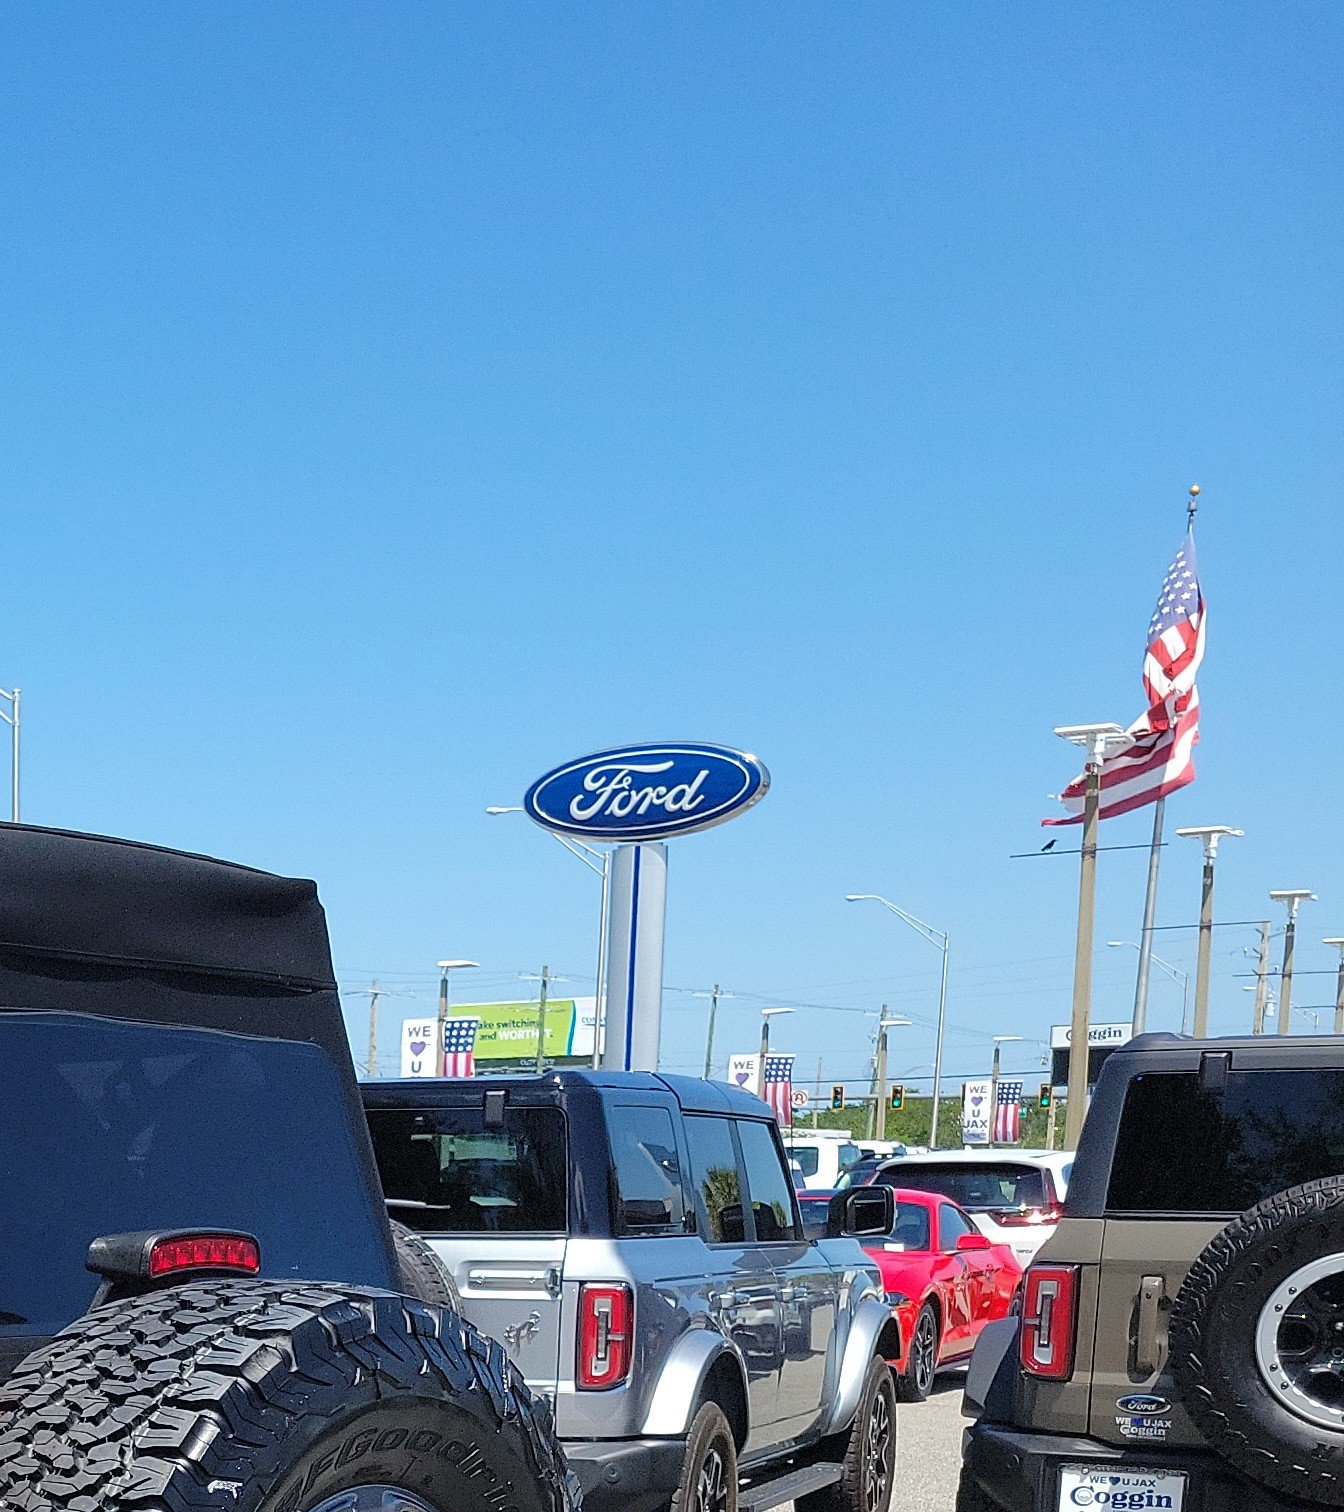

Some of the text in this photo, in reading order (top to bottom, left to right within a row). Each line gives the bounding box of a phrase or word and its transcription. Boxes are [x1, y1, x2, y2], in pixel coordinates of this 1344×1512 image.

[569, 760, 710, 821] Ford
[477, 1021, 494, 1030] ake
[408, 1026, 431, 1037] WE
[411, 1061, 422, 1073] U
[734, 1060, 754, 1070] WE
[969, 1085, 987, 1093] WE
[972, 1109, 980, 1117] U
[963, 1120, 987, 1128] JAX
[1089, 1475, 1156, 1487] WE U JAX
[1070, 1486, 1173, 1510] Coggin
